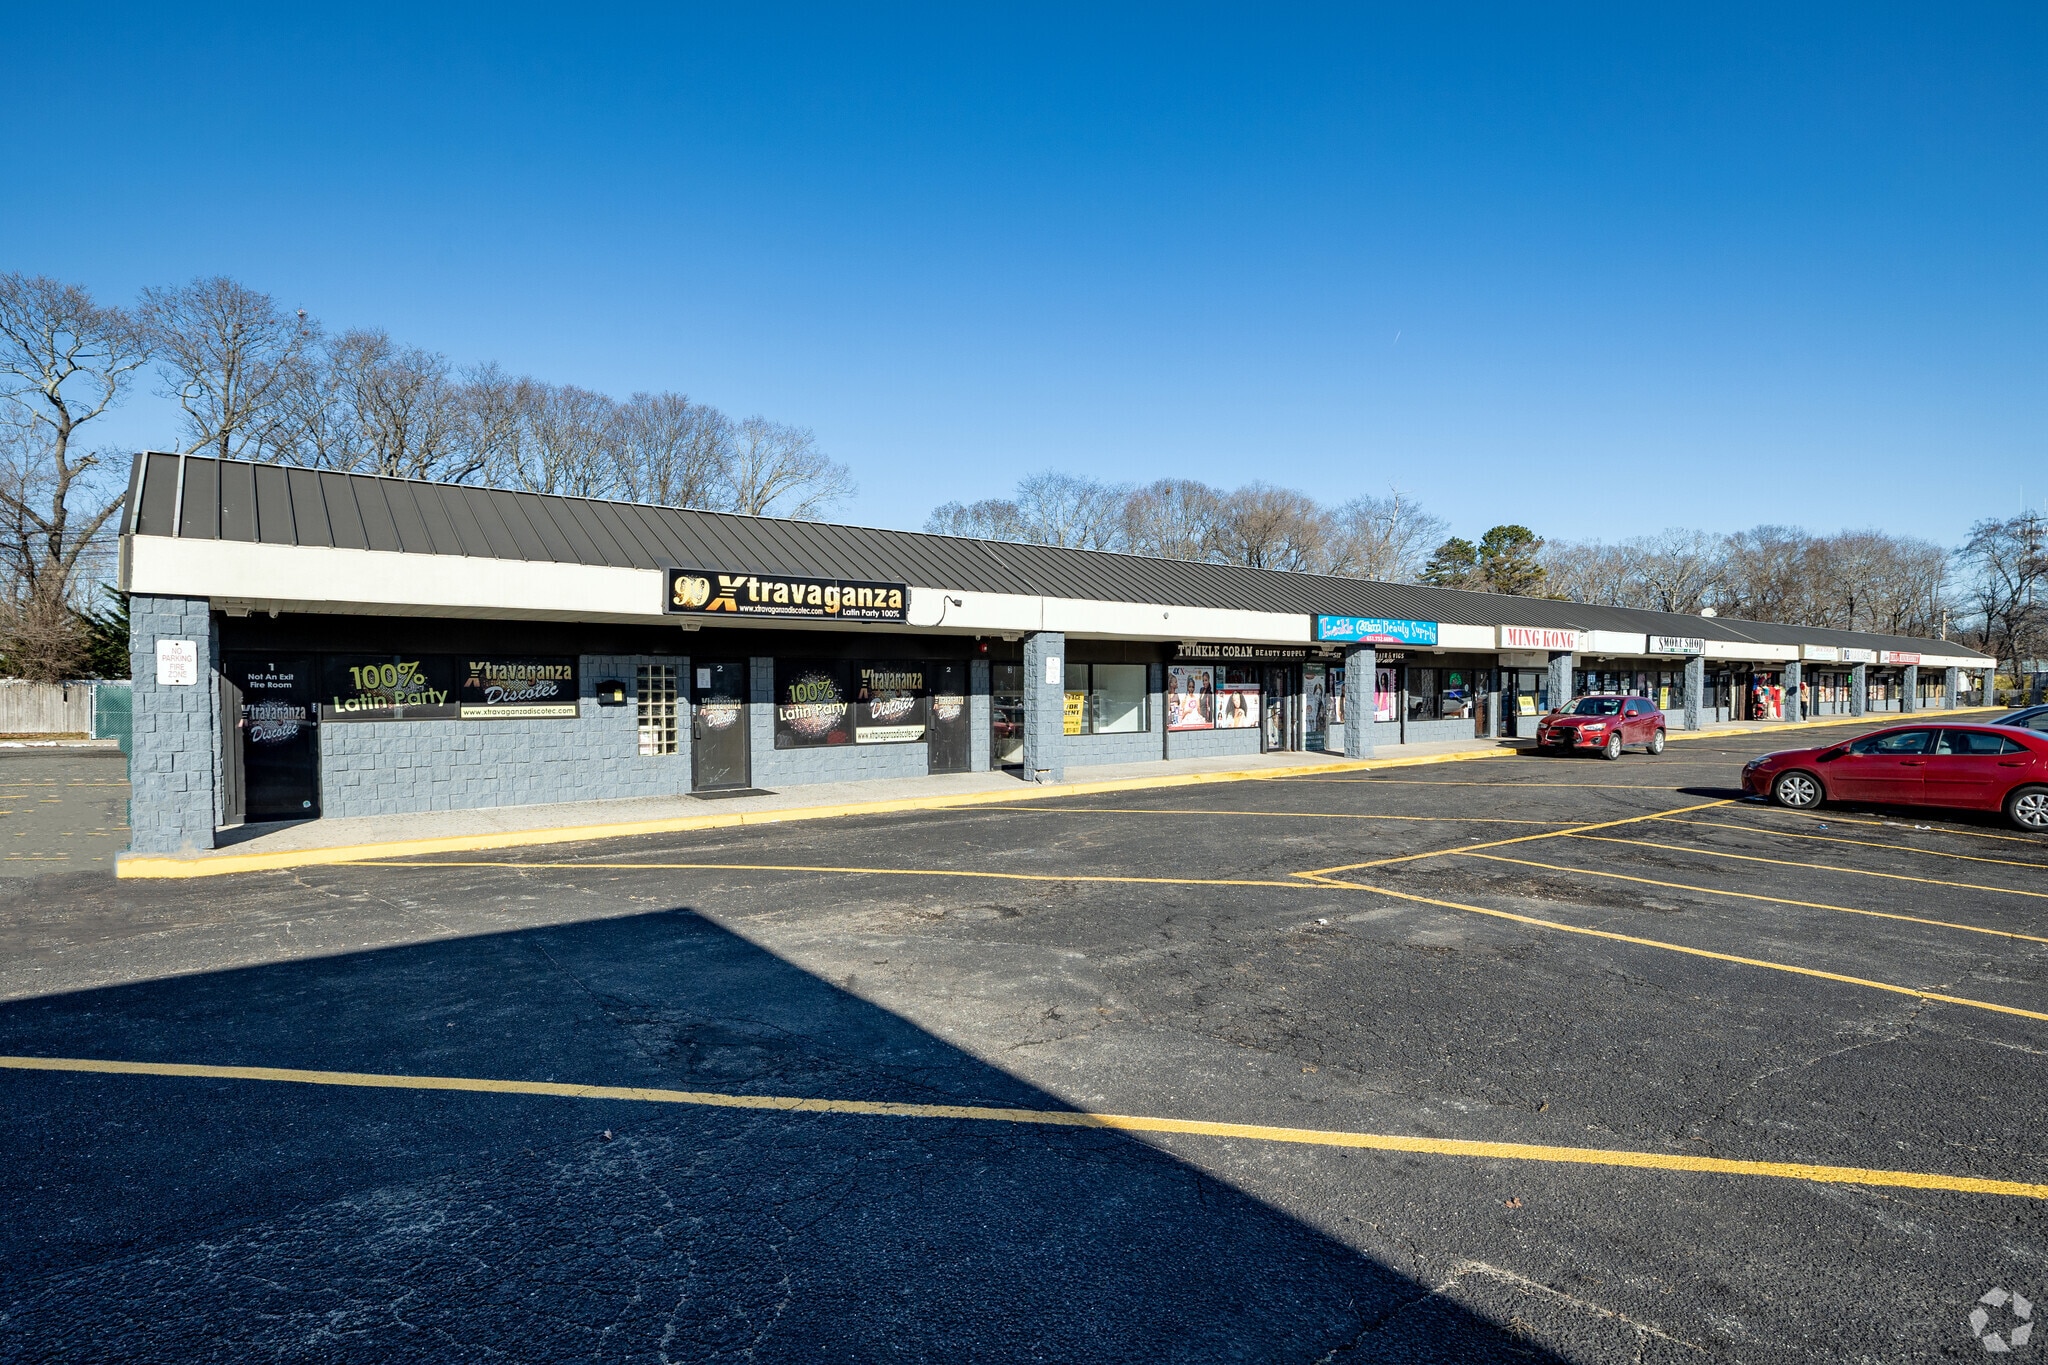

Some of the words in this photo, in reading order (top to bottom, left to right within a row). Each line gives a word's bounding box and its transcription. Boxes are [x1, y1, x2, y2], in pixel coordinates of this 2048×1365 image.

[705, 575, 902, 613] Xtravaganza
[843, 608, 860, 617] Latin
[861, 609, 880, 619] Party
[881, 609, 900, 618] 100%
[1383, 619, 1410, 639] Beauty
[1410, 621, 1436, 644] Supply
[1508, 628, 1540, 647] MING
[1543, 630, 1574, 649] KONG
[171, 647, 183, 655] NO
[1178, 645, 1220, 657] TWINKLE
[1222, 645, 1253, 658] CORAM
[1255, 649, 1280, 657] BEAUTY
[1658, 637, 1682, 652] SMOKE
[1685, 638, 1703, 653] SHOP
[161, 654, 193, 663] PARKING
[169, 663, 185, 671] FIRE
[168, 670, 188, 678] ZONE
[349, 660, 425, 690] 100%
[463, 661, 572, 688] Xtravaganza
[788, 679, 835, 703] 100%
[858, 669, 923, 699] Xtravaganza
[333, 692, 388, 713] Latin
[393, 687, 448, 707] Party
[484, 684, 559, 705] Discotec
[463, 707, 574, 716] www.xtravaganzadiscotec.com
[779, 705, 812, 721] Latin
[815, 702, 848, 716] Party
[250, 724, 298, 742] Discotec
